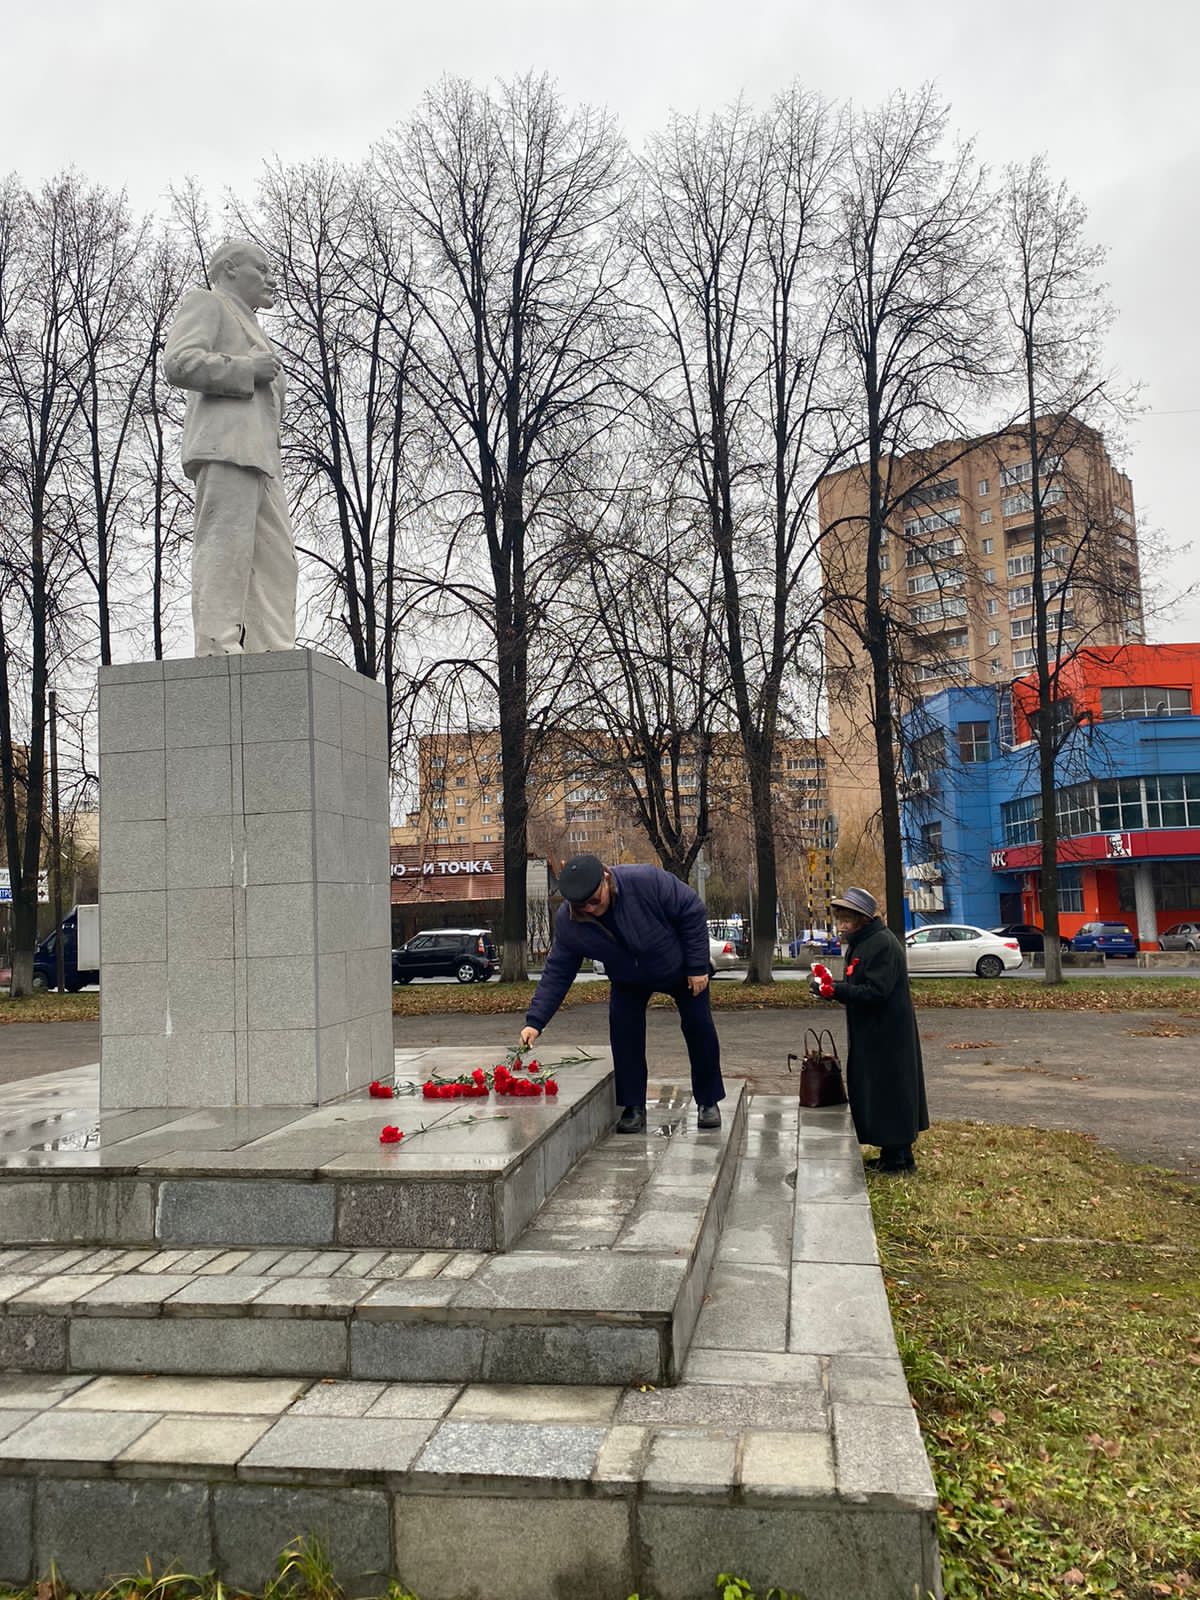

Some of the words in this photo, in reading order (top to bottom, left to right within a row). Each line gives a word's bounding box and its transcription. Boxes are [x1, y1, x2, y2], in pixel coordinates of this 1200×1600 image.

[991, 850, 1006, 867] KFC
[423, 863, 434, 875] И
[438, 861, 493, 874] ТОЧКА
